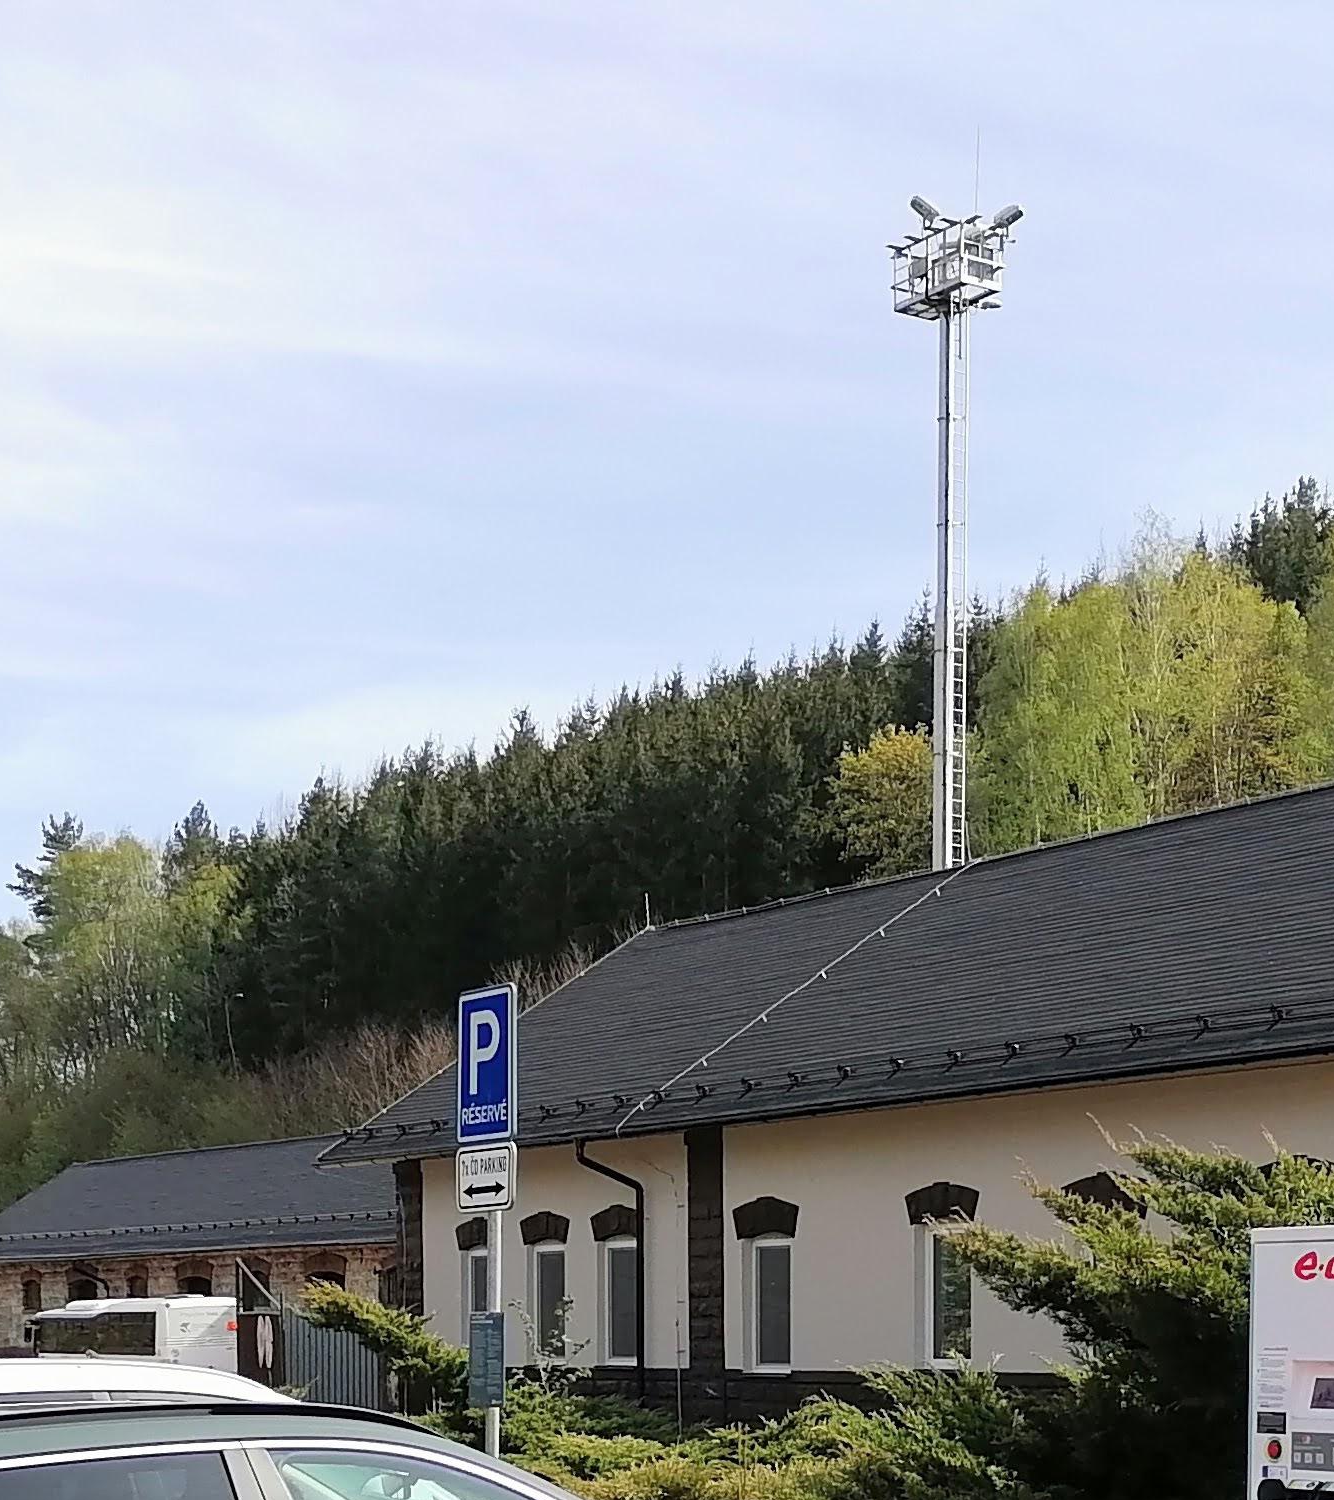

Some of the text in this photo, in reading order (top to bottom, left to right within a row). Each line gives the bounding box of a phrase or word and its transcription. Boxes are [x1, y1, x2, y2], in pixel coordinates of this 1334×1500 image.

[470, 1010, 500, 1095] P
[462, 1098, 507, 1126] RÉSERVÉ
[480, 1156, 506, 1174] PARKING
